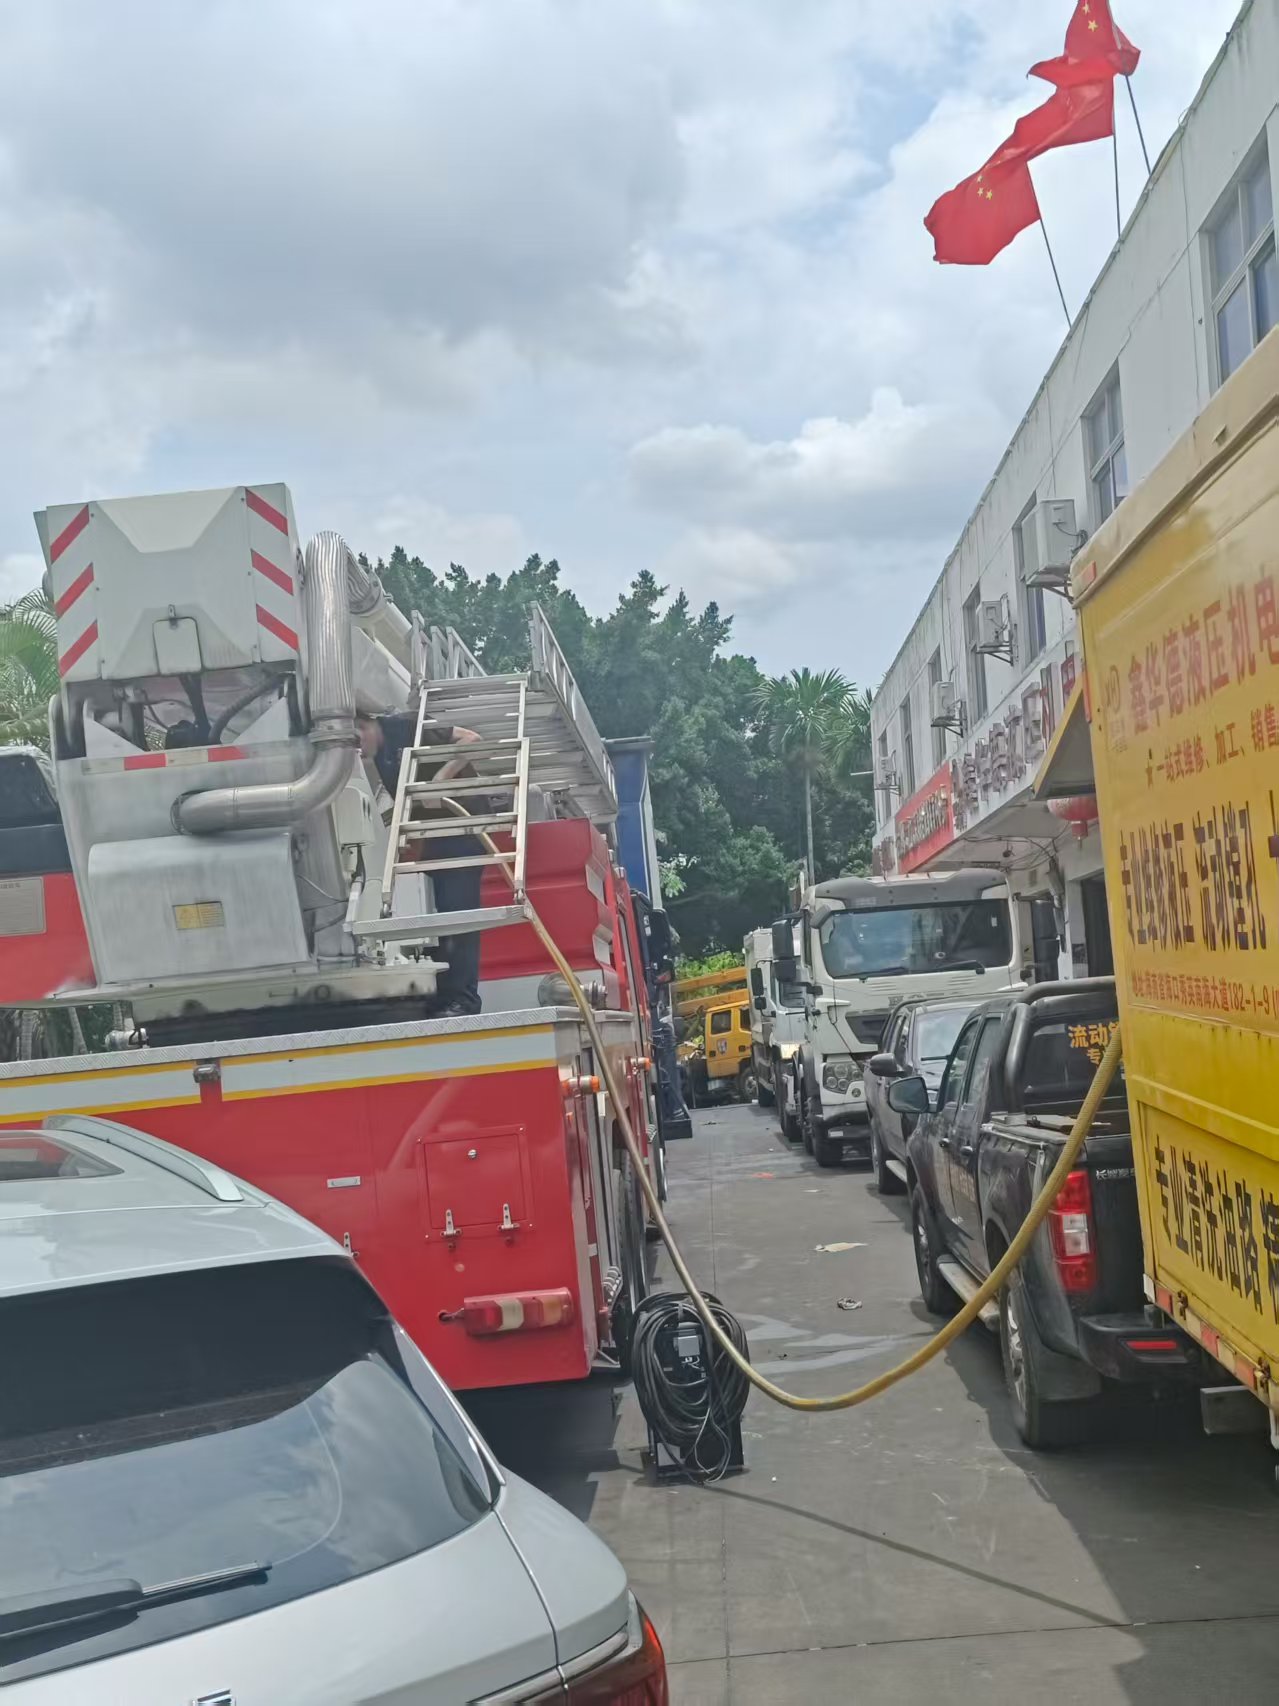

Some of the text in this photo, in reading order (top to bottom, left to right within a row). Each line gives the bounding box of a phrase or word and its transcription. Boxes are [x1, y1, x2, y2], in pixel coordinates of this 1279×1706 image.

[1086, 1047, 1107, 1065] 专
[1154, 1134, 1264, 1316] 专业清洗油路
